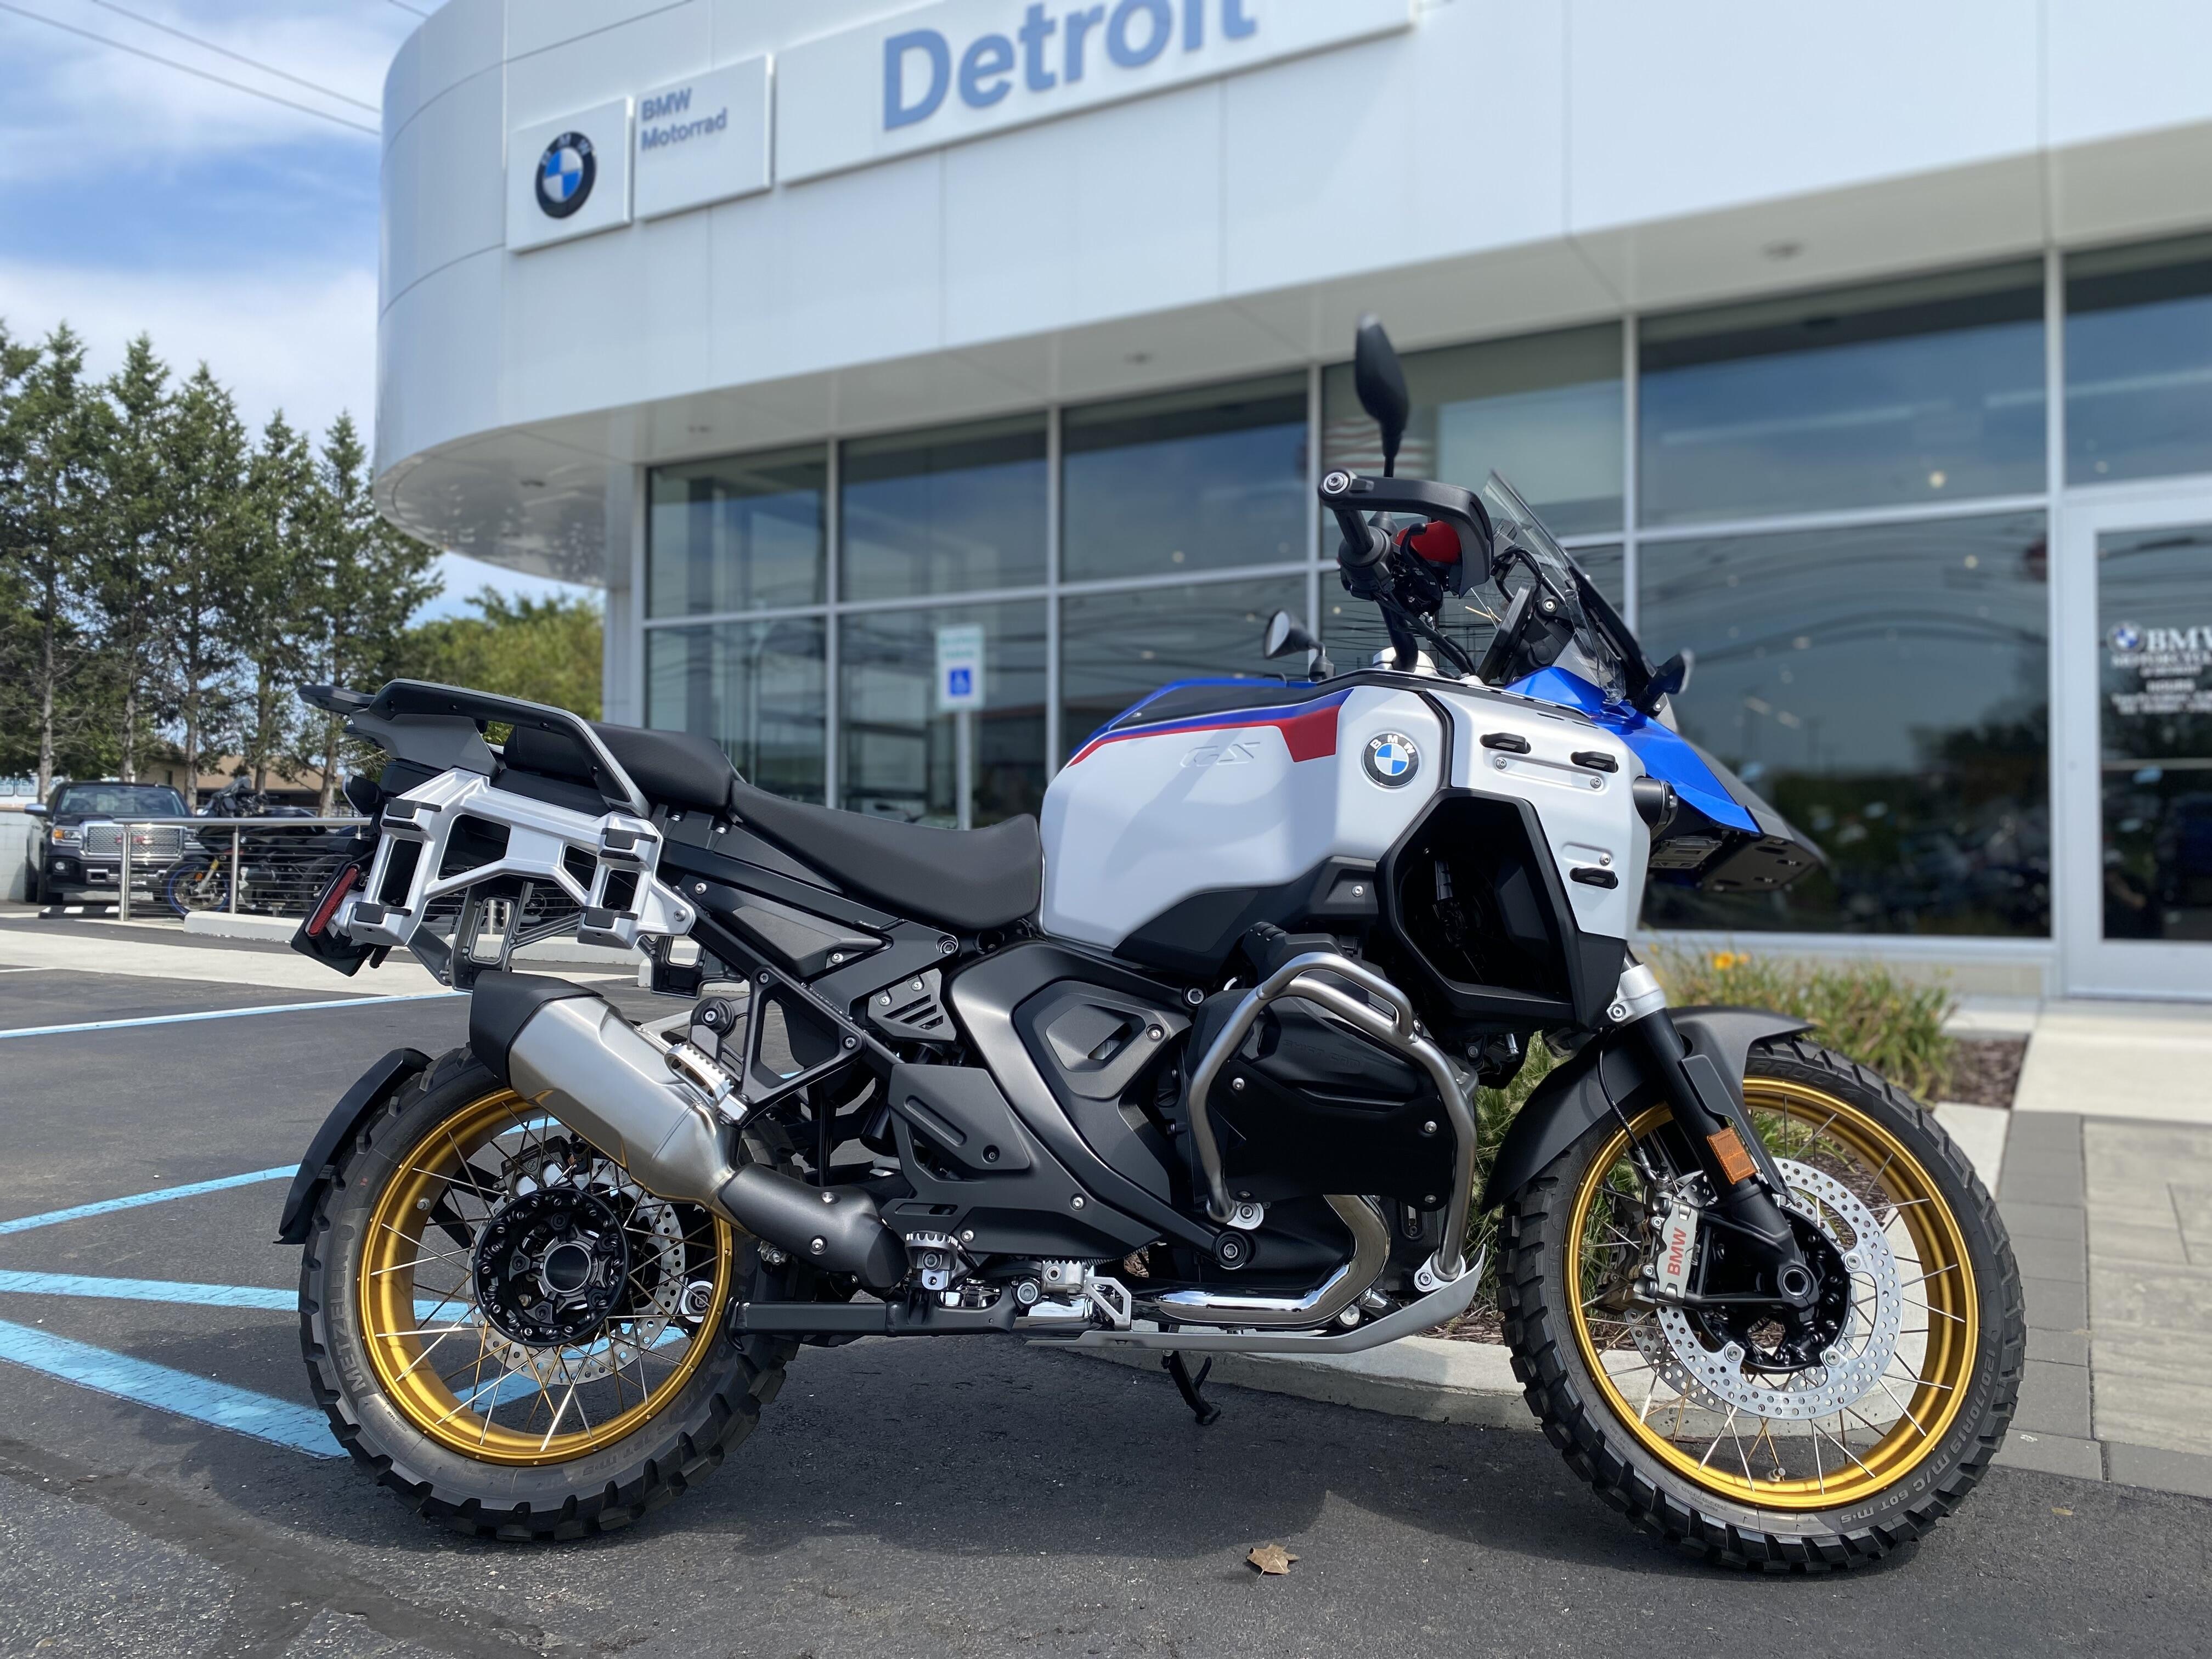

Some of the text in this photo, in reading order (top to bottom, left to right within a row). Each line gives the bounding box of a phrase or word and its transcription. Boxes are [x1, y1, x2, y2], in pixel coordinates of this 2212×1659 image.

[641, 87, 692, 122] BMW
[641, 107, 727, 151] Motorrad
[541, 133, 592, 167] BMW
[1180, 741, 1261, 768] GS
[1370, 734, 1416, 754] BMW
[1747, 1060, 1833, 1085] AROO
[1667, 1227, 1686, 1276] BMW
[329, 1254, 366, 1393] METZELER
[1548, 1242, 1585, 1388] METZELER
[1950, 1349, 1996, 1454] 120/70R19
[1912, 1454, 1950, 1492] M/C
[1880, 1489, 1909, 1511] 60T
